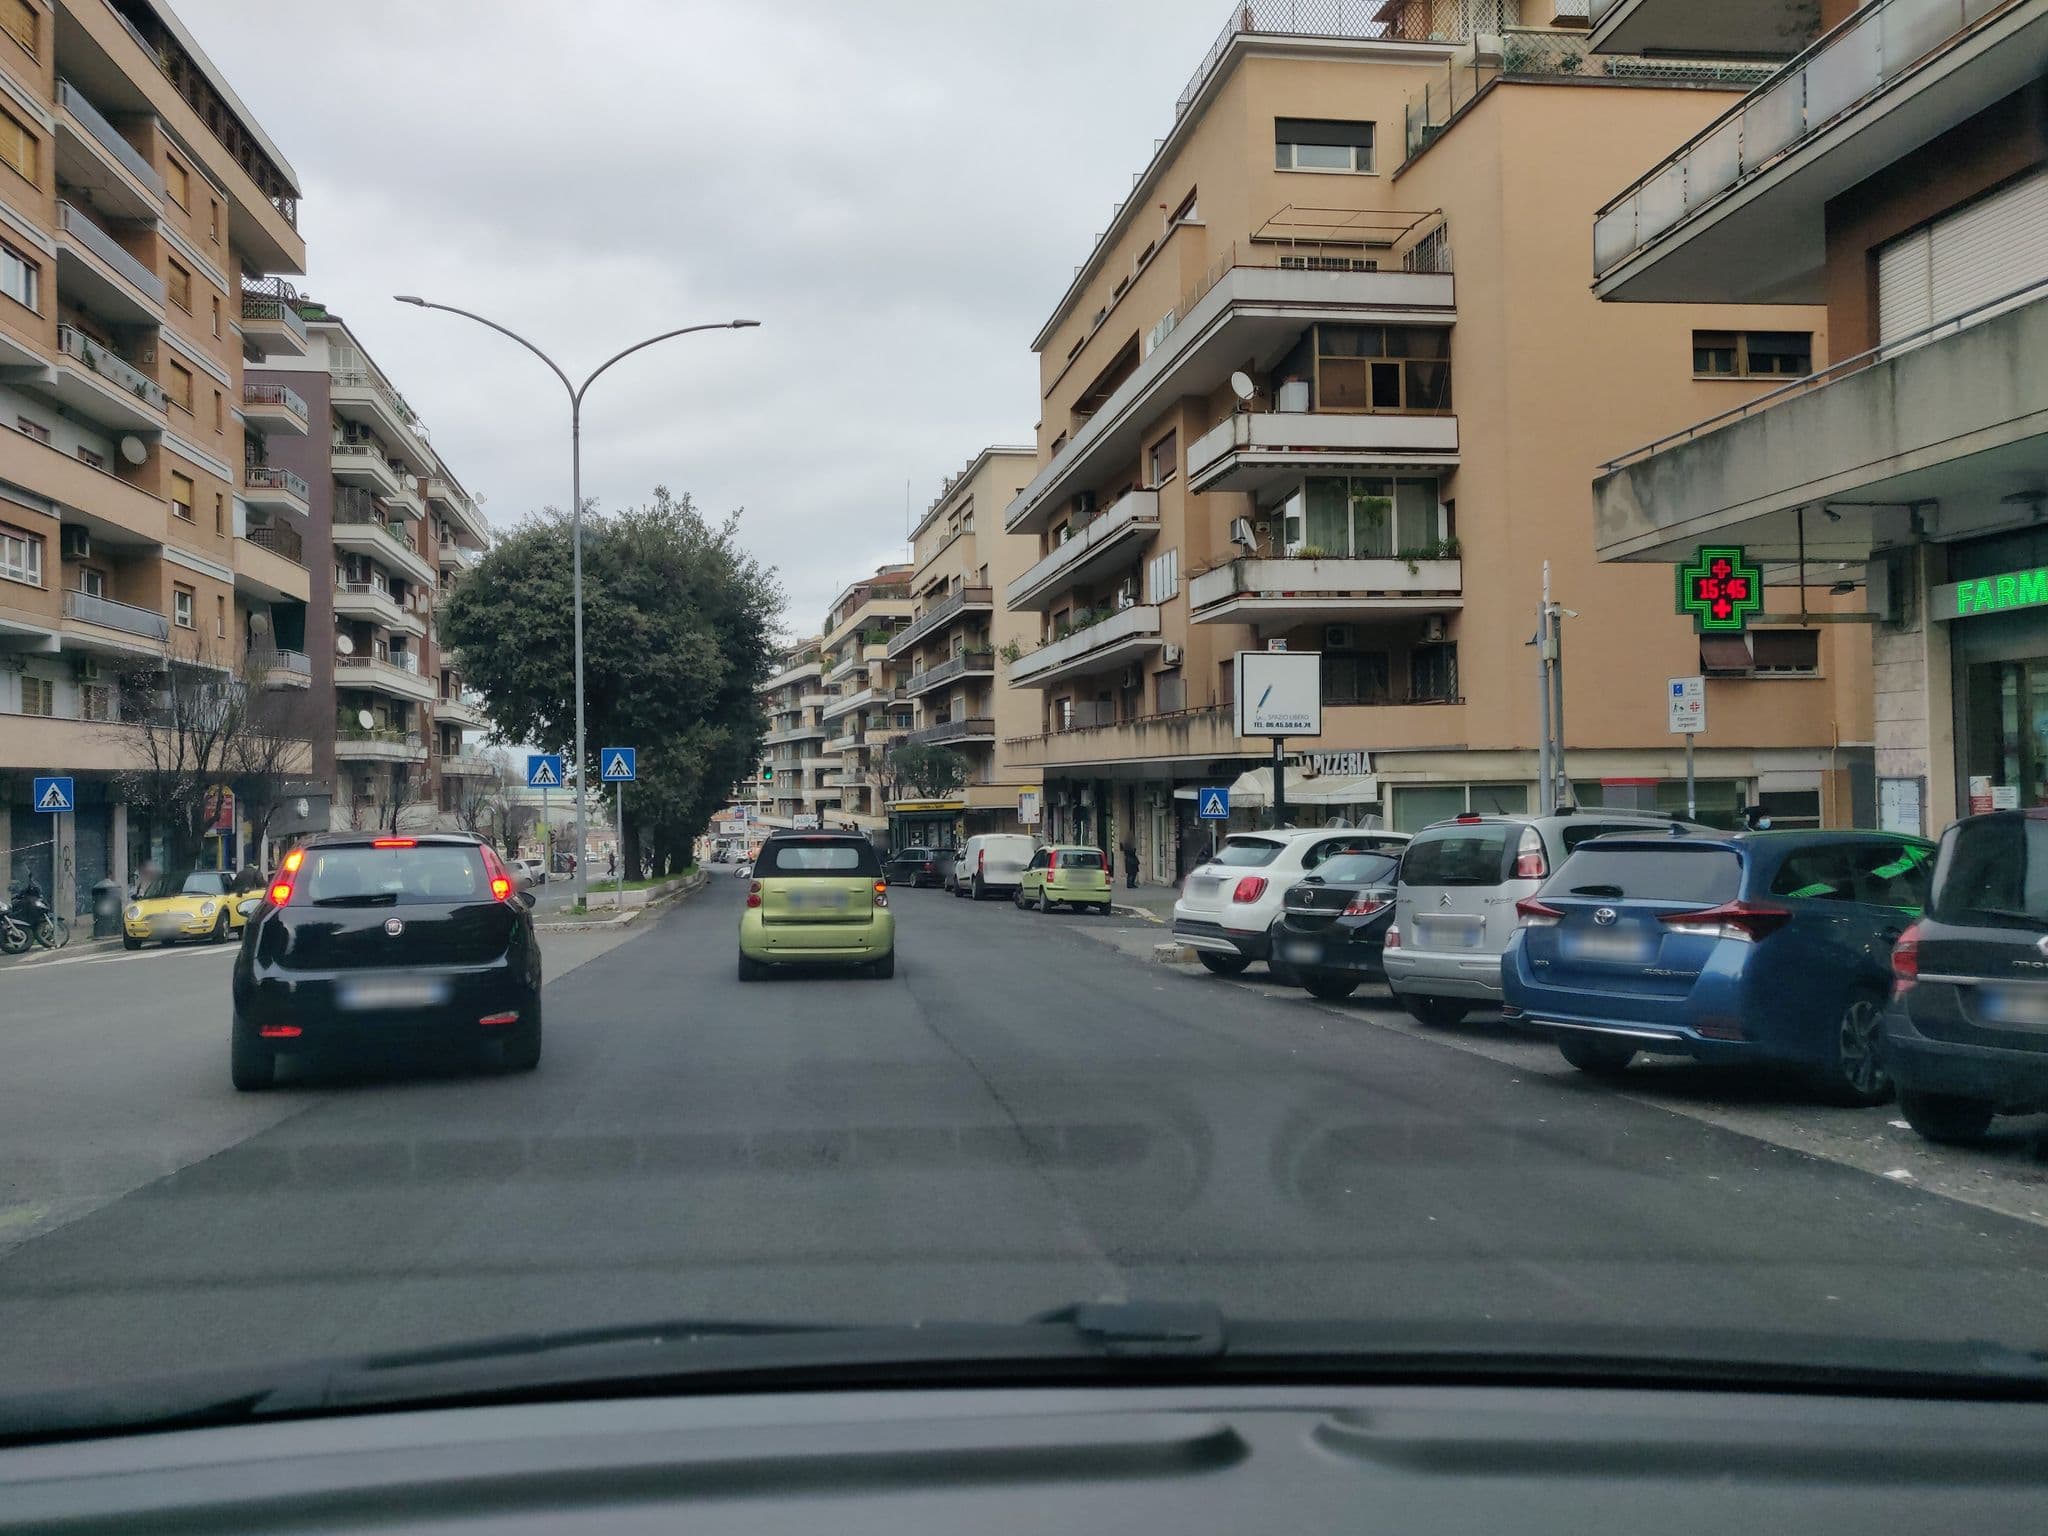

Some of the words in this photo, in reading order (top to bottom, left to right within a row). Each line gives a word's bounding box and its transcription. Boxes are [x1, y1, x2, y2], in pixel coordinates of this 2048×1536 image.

[1699, 579, 1746, 599] 15:45
[1957, 569, 2048, 615] FARM
[1313, 752, 1372, 775] PIZZERIA
